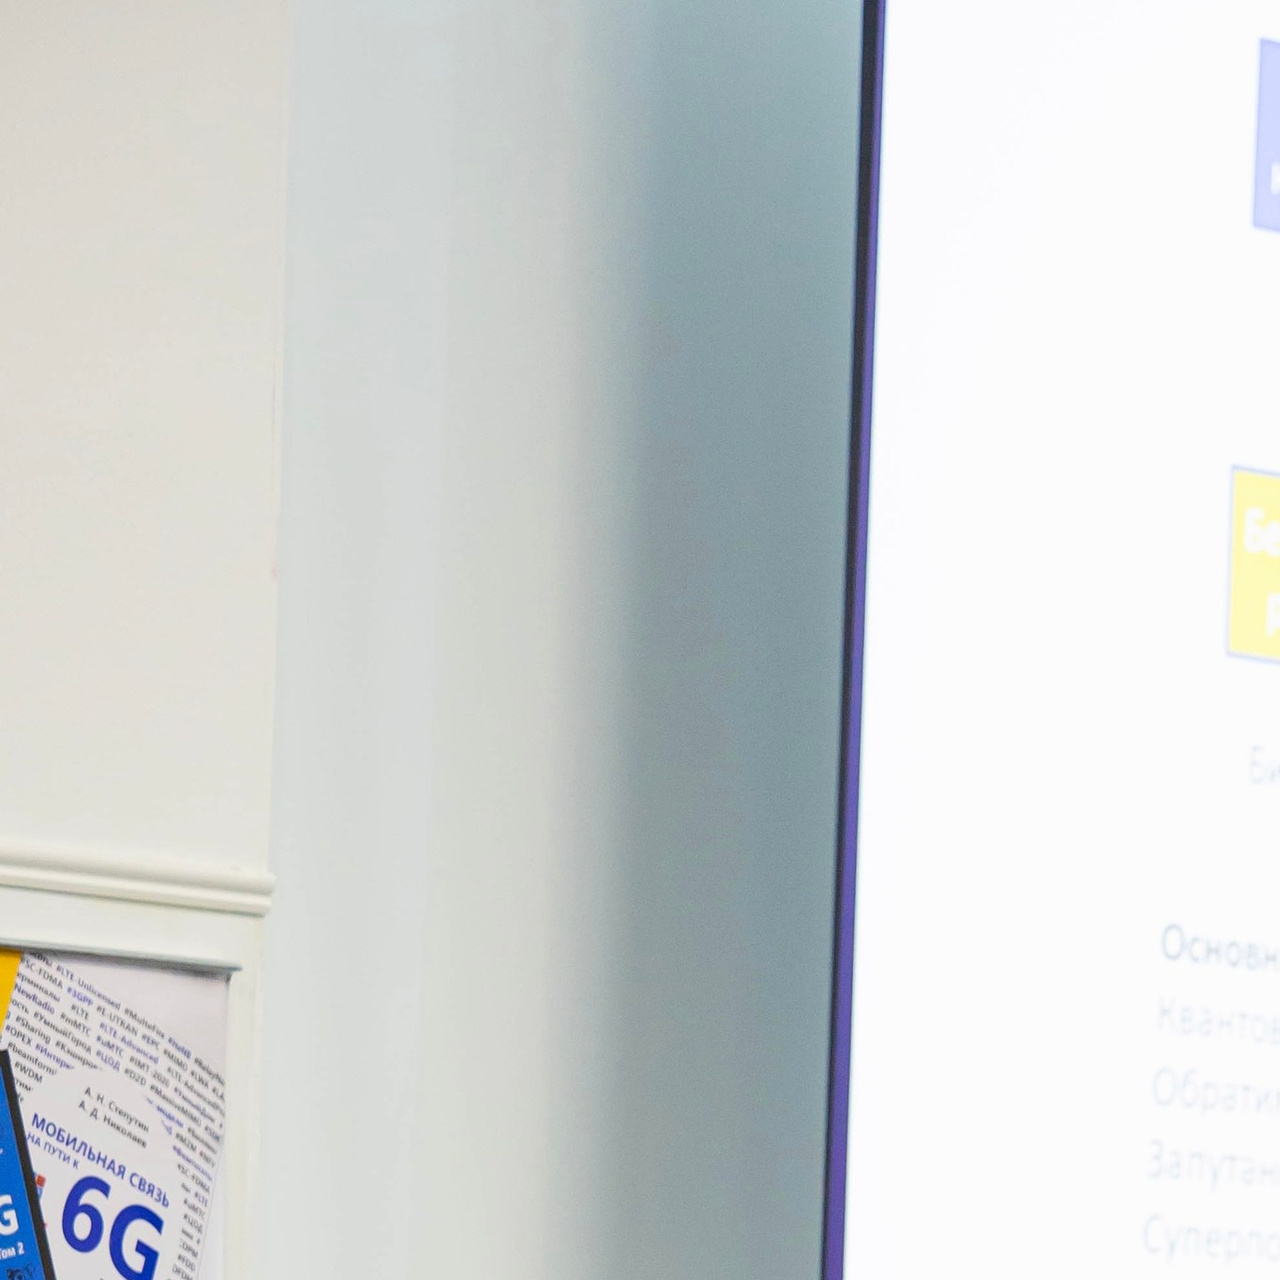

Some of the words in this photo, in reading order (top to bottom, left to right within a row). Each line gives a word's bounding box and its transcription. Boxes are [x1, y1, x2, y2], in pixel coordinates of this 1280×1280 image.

[103, 1113, 148, 1149] Николаев
[108, 1100, 150, 1133] Степутин
[27, 1132, 41, 1149] НА
[44, 1140, 71, 1164] ПУТИ
[31, 1112, 127, 1180] МОБИЛЬНАЯ
[129, 1171, 170, 1208] СВЯЗЬ
[17, 1241, 25, 1255] 2
